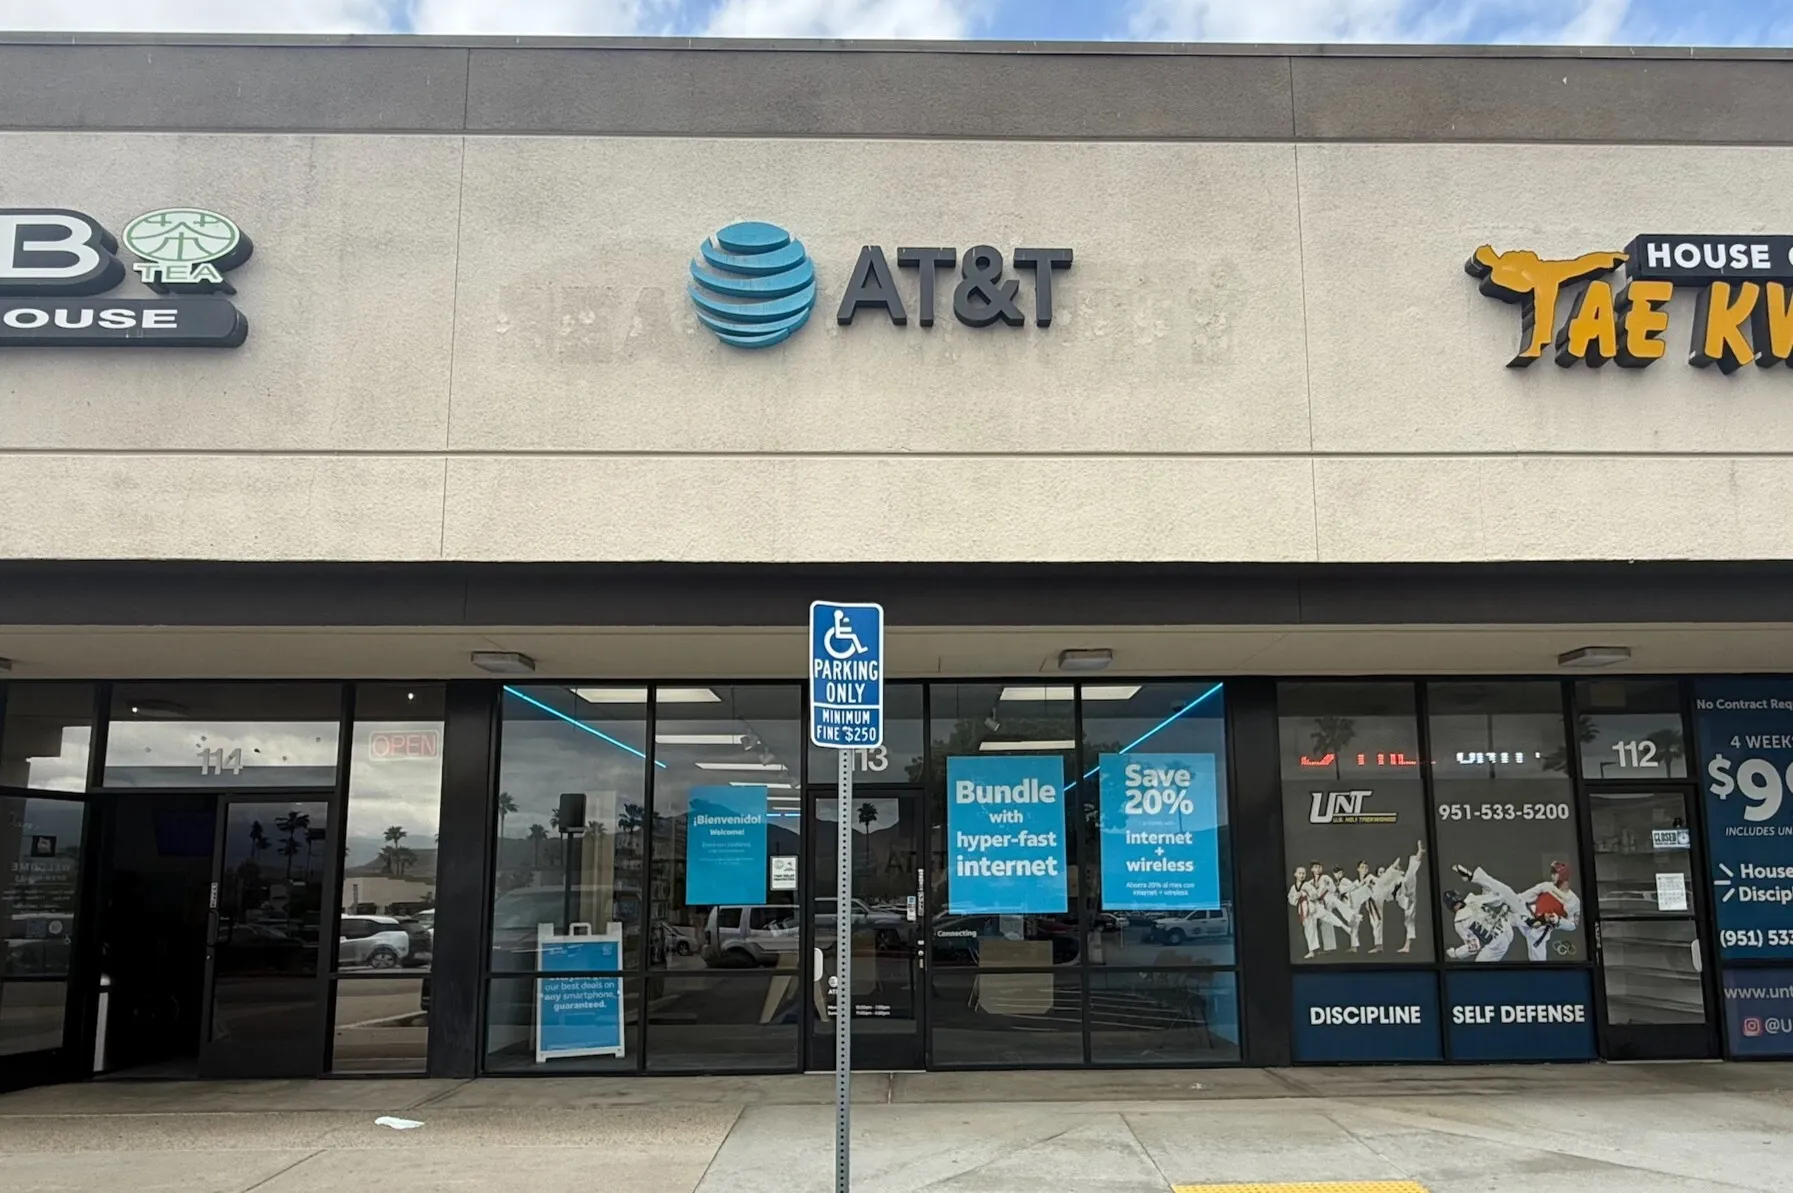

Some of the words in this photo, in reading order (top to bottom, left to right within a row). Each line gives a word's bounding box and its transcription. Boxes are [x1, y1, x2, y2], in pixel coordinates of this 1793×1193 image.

[1646, 242, 1771, 269] HOUSE
[133, 262, 223, 284] TEA
[836, 244, 1073, 328] AT&T
[814, 658, 879, 681] PARKING
[826, 681, 866, 704] ONLY
[1696, 699, 1714, 710] No
[1716, 699, 1768, 710] Contract
[822, 709, 871, 725] MINIMUM
[816, 726, 840, 741] FINE
[844, 726, 877, 742] $250
[1730, 735, 1741, 749] 4
[1745, 735, 1793, 749] WEEK
[371, 733, 437, 758] OPEN
[1612, 740, 1659, 768] 112
[196, 747, 244, 776] 114
[1124, 763, 1191, 788] Save
[955, 778, 1057, 804] Bundle
[1707, 753, 1793, 822] $9
[1124, 789, 1194, 816] 20%
[1309, 790, 1373, 824] UNT
[693, 814, 762, 827] ¡Bienvenido!
[989, 808, 1024, 824] with
[1438, 803, 1570, 821] 951-533-5200
[710, 828, 745, 836] Welcome!
[1125, 829, 1193, 845] internet
[1654, 832, 1677, 842] CLOSED
[1725, 826, 1775, 837] INCLUDES
[956, 830, 1057, 851] hyper-fast
[1154, 846, 1165, 857] +
[956, 855, 1058, 877] internet
[1126, 856, 1194, 873] wireless
[1740, 863, 1793, 879] House
[937, 930, 977, 938] Connecting
[1720, 929, 1763, 948] (951)
[544, 983, 559, 991] our
[561, 982, 579, 990] best
[581, 981, 602, 989] deals
[1724, 984, 1793, 999] www.unt
[544, 993, 561, 1002] any
[553, 1000, 607, 1012] guaranteed.
[1310, 1005, 1421, 1025] DISCIPLINE
[1452, 1006, 1495, 1024] SELF
[1500, 1005, 1585, 1024] DEFENSE
[1765, 1017, 1793, 1034] @U
